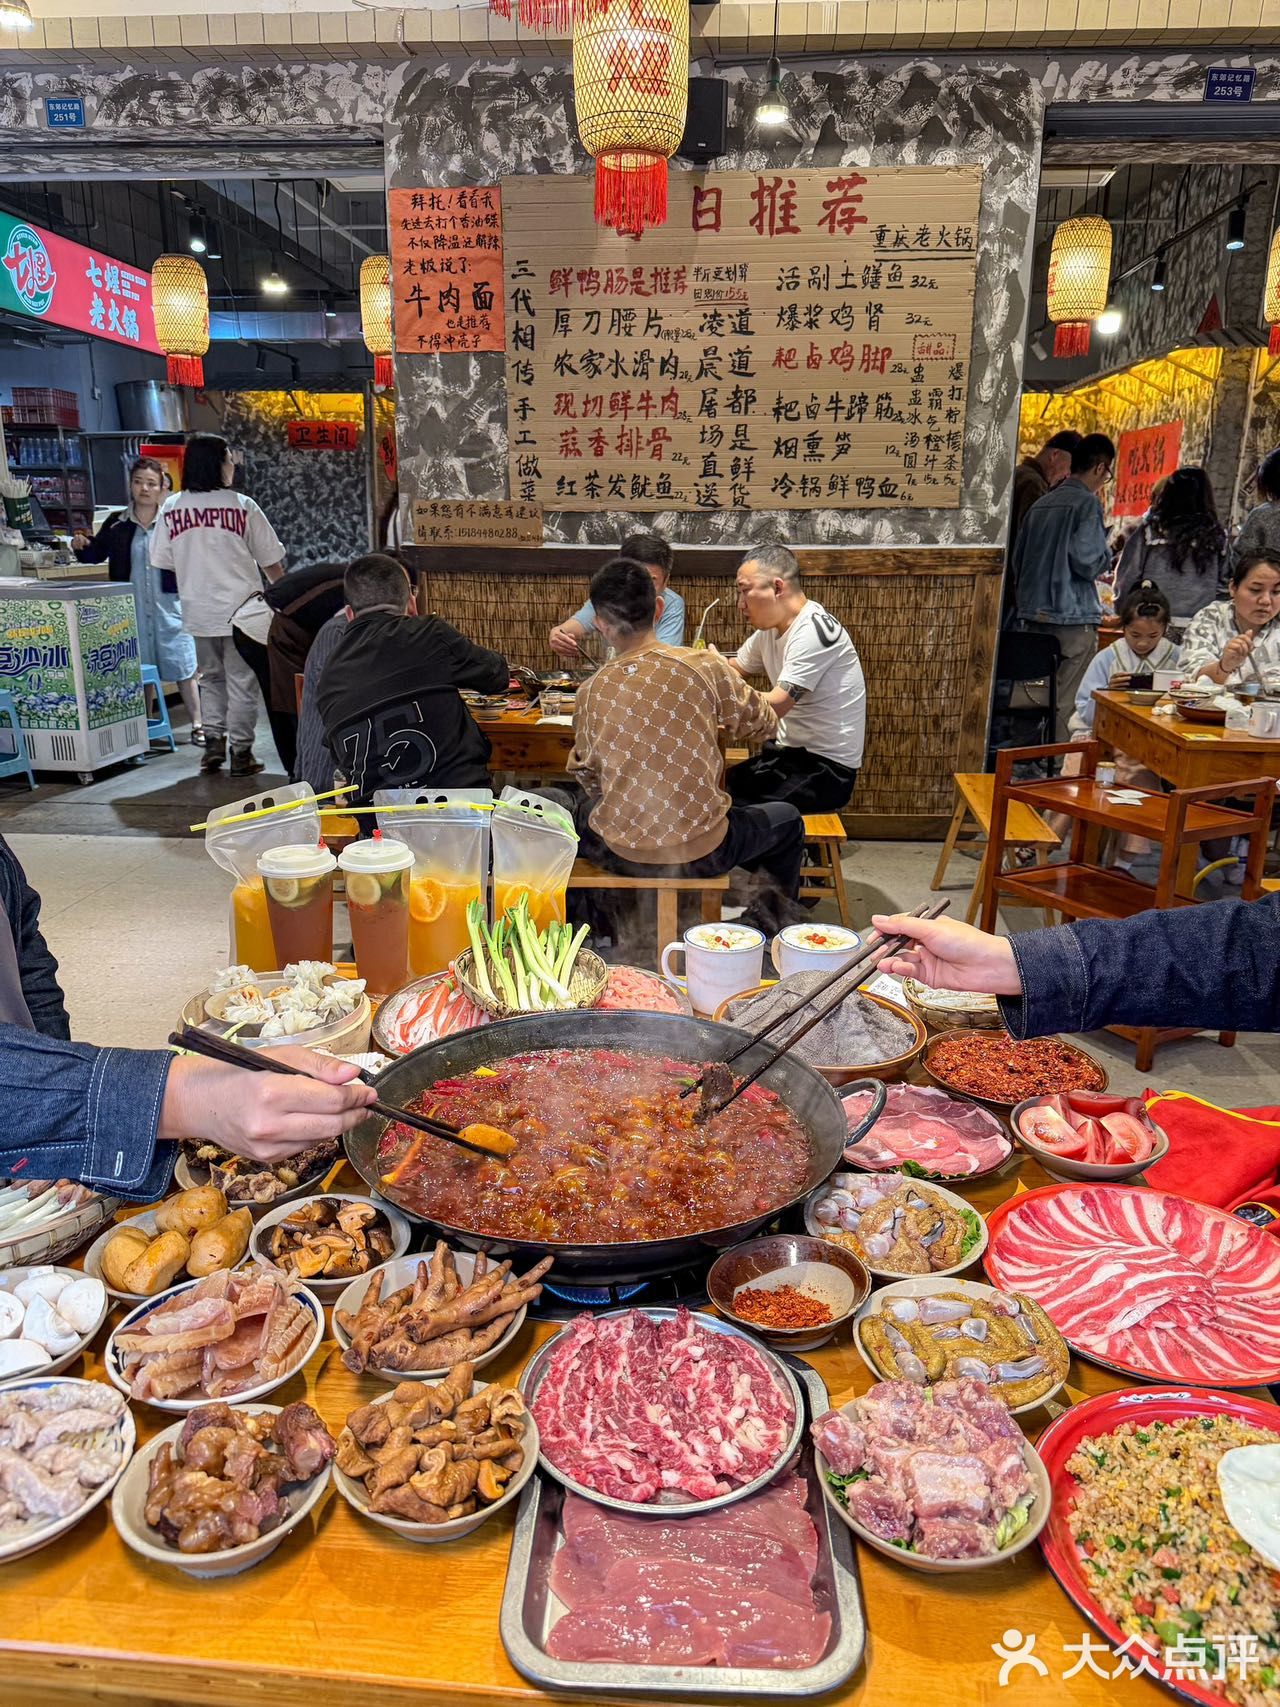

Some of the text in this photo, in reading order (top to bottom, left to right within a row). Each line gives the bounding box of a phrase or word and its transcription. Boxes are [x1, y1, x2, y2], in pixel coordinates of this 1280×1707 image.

[1211, 73, 1251, 83] 东郊记忆路
[1213, 86, 1243, 97] 253号
[53, 112, 77, 122] 251号
[614, 172, 868, 241] 日推荐
[870, 223, 973, 250] 重庆老火锅
[548, 265, 688, 299] 鲜鸭肠是推荐
[776, 262, 905, 292] 活剐土鳝鱼
[404, 281, 495, 319] 牛肉面
[89, 291, 140, 343] 老火锅
[446, 313, 492, 331] 也是推荐
[552, 307, 664, 339] 厚刀腰片
[776, 301, 884, 332] 爆浆鸡肾
[416, 332, 482, 351] 不得冲壳子
[553, 348, 679, 380] 农家水滑肉
[511, 259, 543, 502] 三代相传手工做菜
[553, 385, 681, 421] 现切鲜牛肉
[294, 425, 349, 446] 卫生间
[559, 423, 673, 462] 蒜香排骨
[772, 429, 852, 462] 烟熏笋
[555, 469, 675, 501] 红茶发鱿鱼
[771, 472, 899, 499] 冷锅鲜鸭血
[163, 507, 248, 541] CHAMPION
